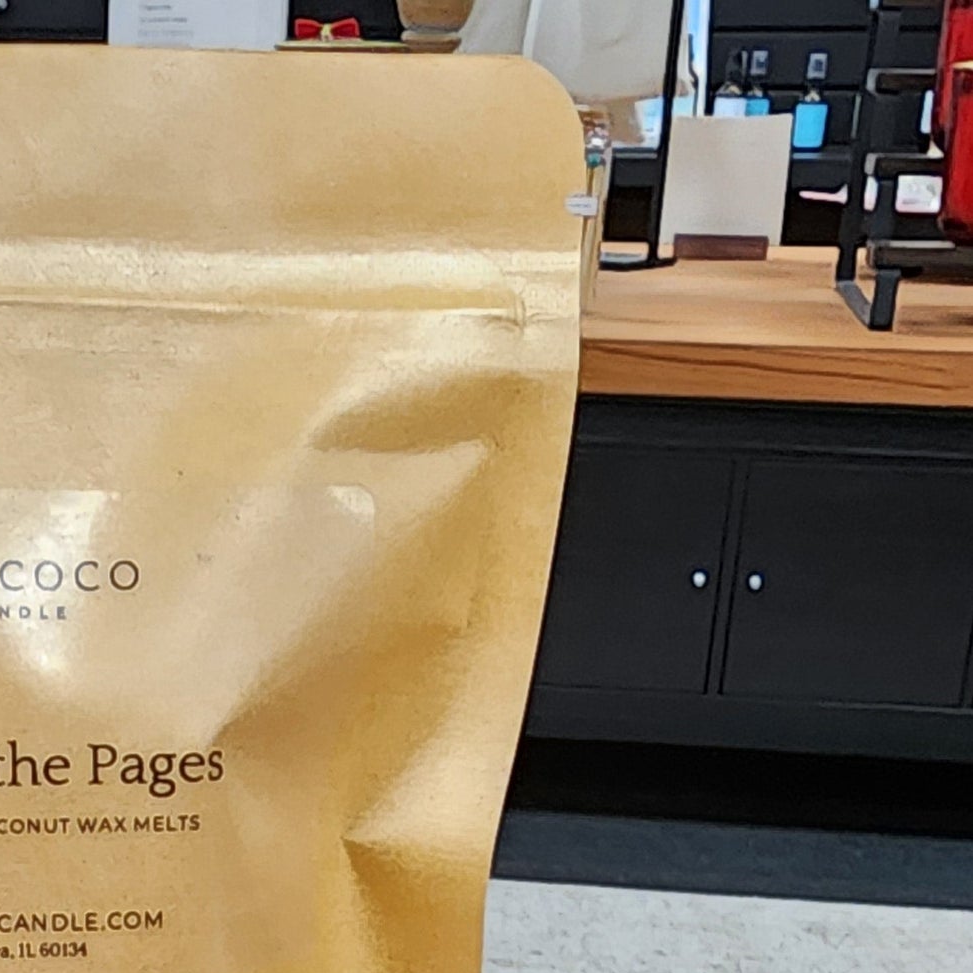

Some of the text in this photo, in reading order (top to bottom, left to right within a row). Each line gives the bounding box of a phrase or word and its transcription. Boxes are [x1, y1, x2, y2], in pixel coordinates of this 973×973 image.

[87, 743, 225, 798] Pages
[77, 817, 128, 834] WAX
[133, 815, 201, 833] MELTS
[19, 943, 37, 959] IL
[39, 942, 88, 958] 60134
